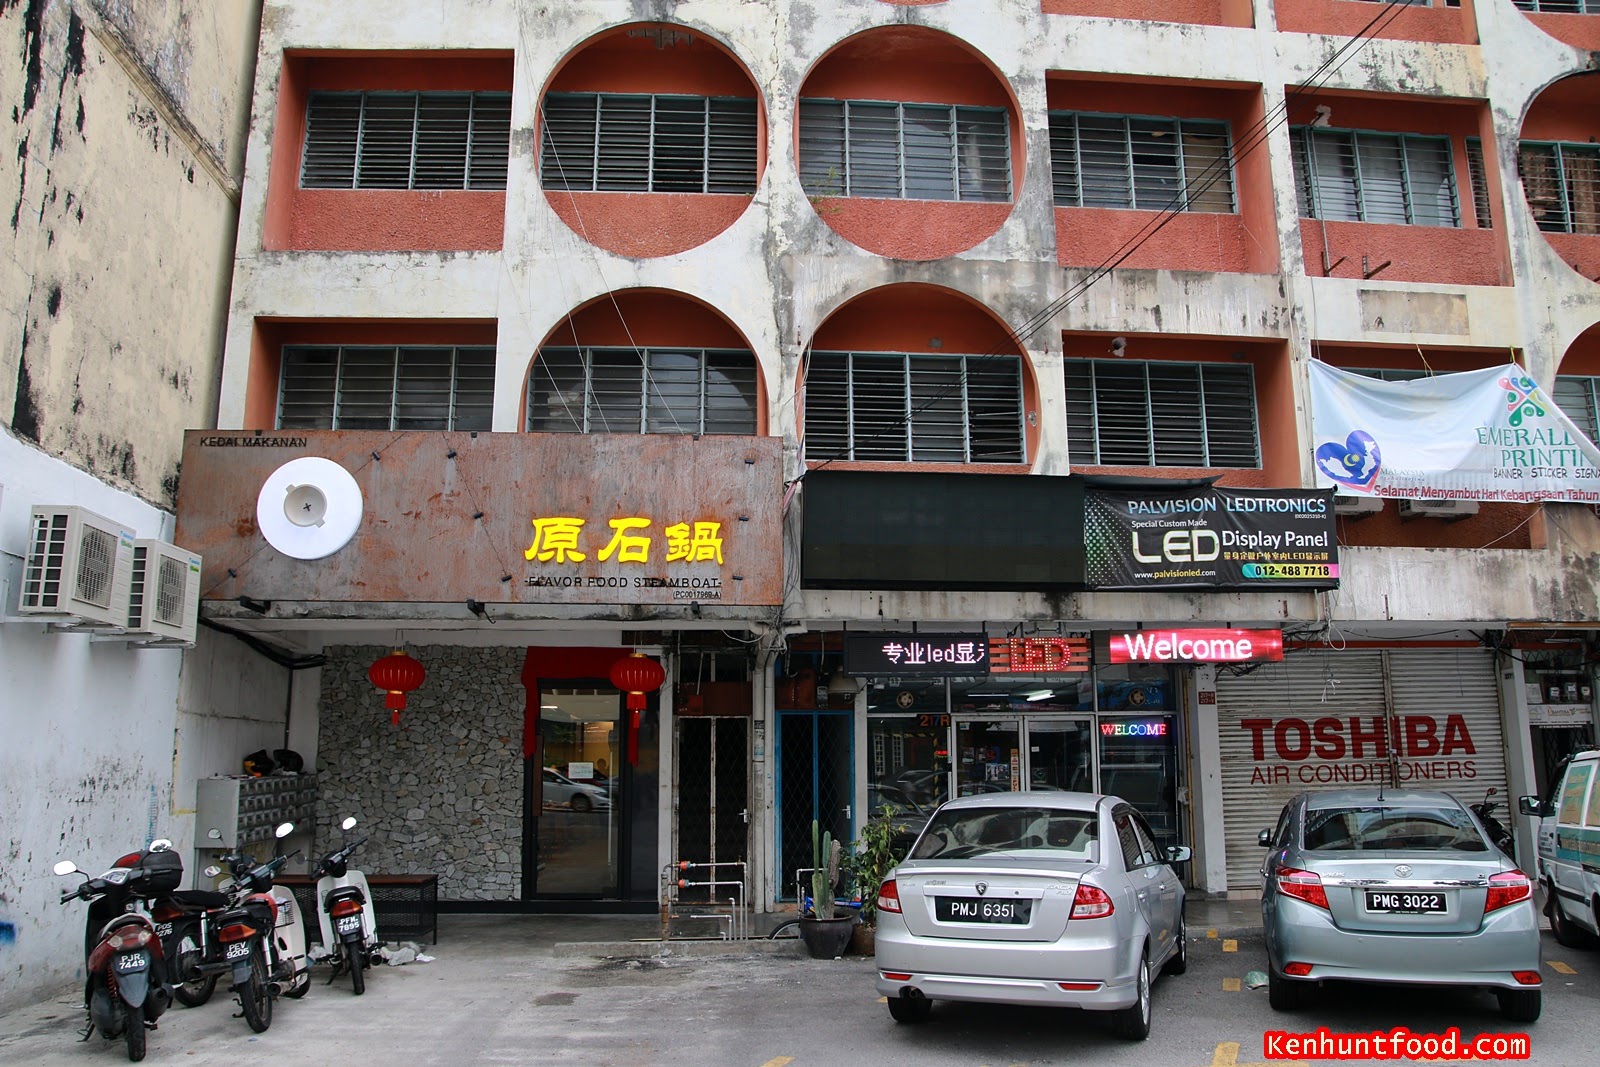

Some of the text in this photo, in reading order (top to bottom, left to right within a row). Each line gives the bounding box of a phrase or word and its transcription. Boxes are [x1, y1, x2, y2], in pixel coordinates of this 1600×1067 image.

[200, 437, 307, 447] KEDAI MAKANAN
[1380, 468, 1425, 476] MALAYSIA
[1494, 468, 1523, 479] BANNER
[1531, 468, 1568, 478] STICKER
[1374, 485, 1599, 502] Selamat Menyambut Hari Kebangsaan Tahun
[1128, 497, 1326, 514] PALVISION LEDTRONICS
[1131, 520, 1158, 528] Special
[524, 517, 724, 564] 原石鍋
[1132, 530, 1328, 563] LED Display Panel
[1134, 569, 1216, 579] www.palvisionled.com
[1281, 566, 1301, 576] 488
[1303, 566, 1330, 576] 7718
[587, 577, 628, 588] FOOD
[1124, 633, 1253, 660] Welcome
[1009, 637, 1071, 672] LED
[920, 715, 949, 727] 217R
[1101, 724, 1167, 736] WELCOME
[1241, 714, 1477, 761] TOSHIBA
[1251, 766, 1290, 785] AIR
[1373, 894, 1439, 908] PMG 3022
[951, 902, 1014, 917] PMJ 6351
[229, 942, 246, 951] PEV
[121, 953, 140, 963] PJR
[226, 948, 249, 959] 9205
[119, 960, 145, 969] 7449
